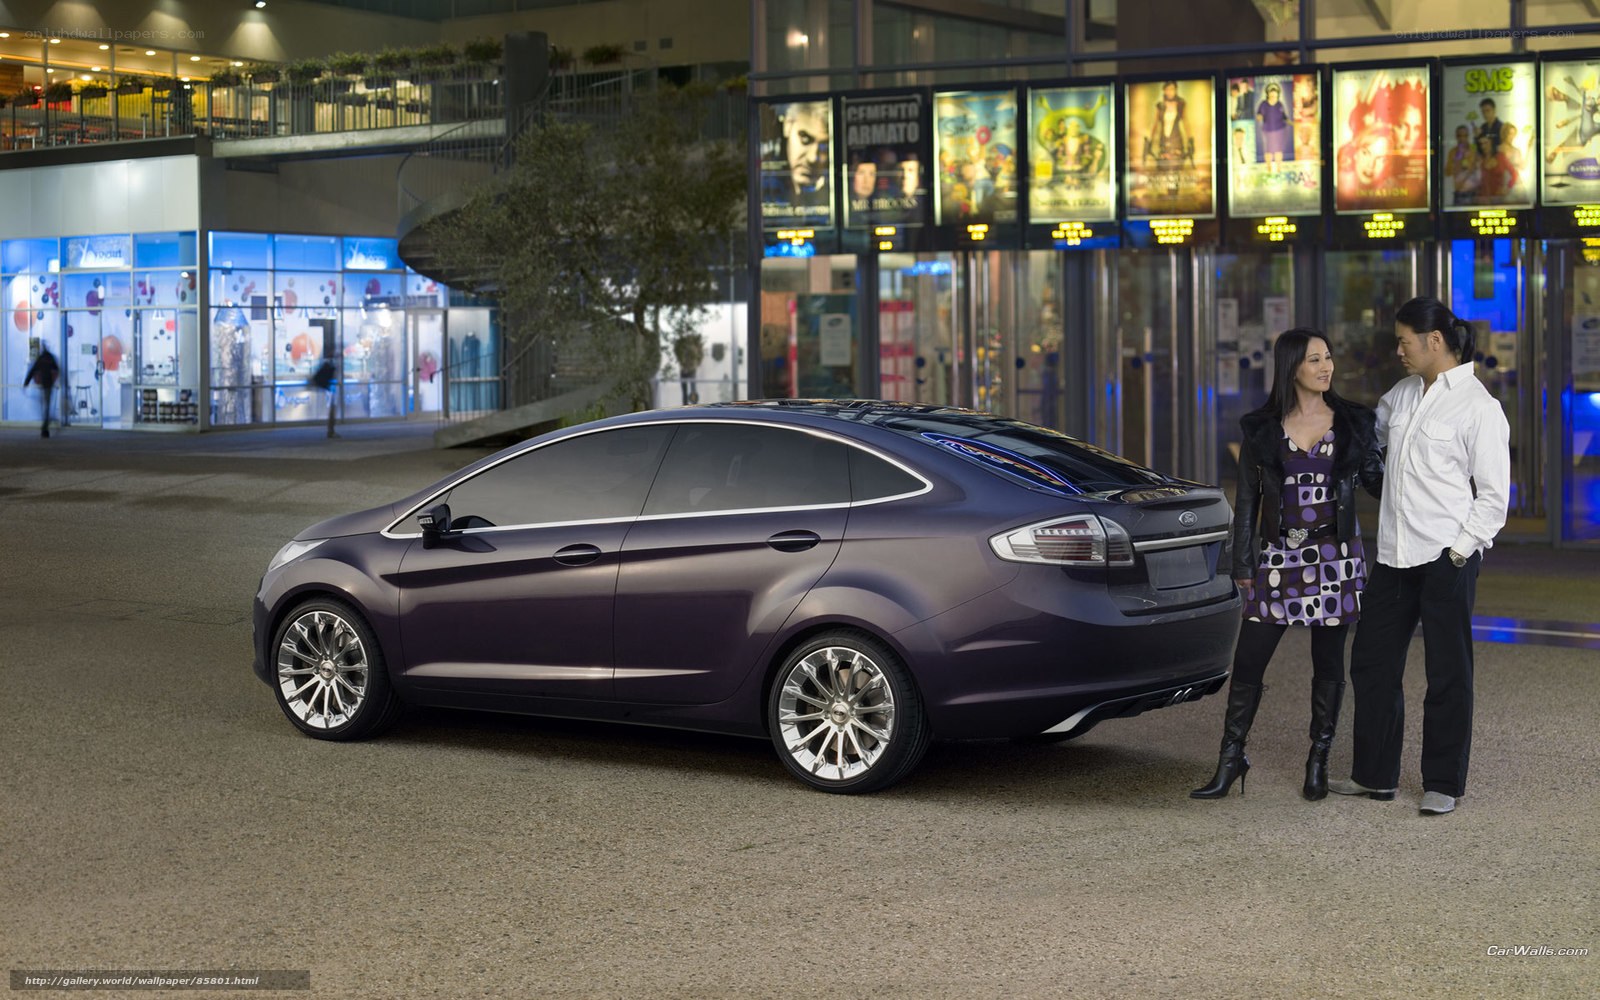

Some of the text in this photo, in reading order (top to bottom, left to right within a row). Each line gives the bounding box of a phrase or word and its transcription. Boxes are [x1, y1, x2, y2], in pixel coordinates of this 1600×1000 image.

[1464, 67, 1513, 93] SMS
[847, 102, 919, 122] CEMENTO
[848, 121, 919, 146] ARMATO
